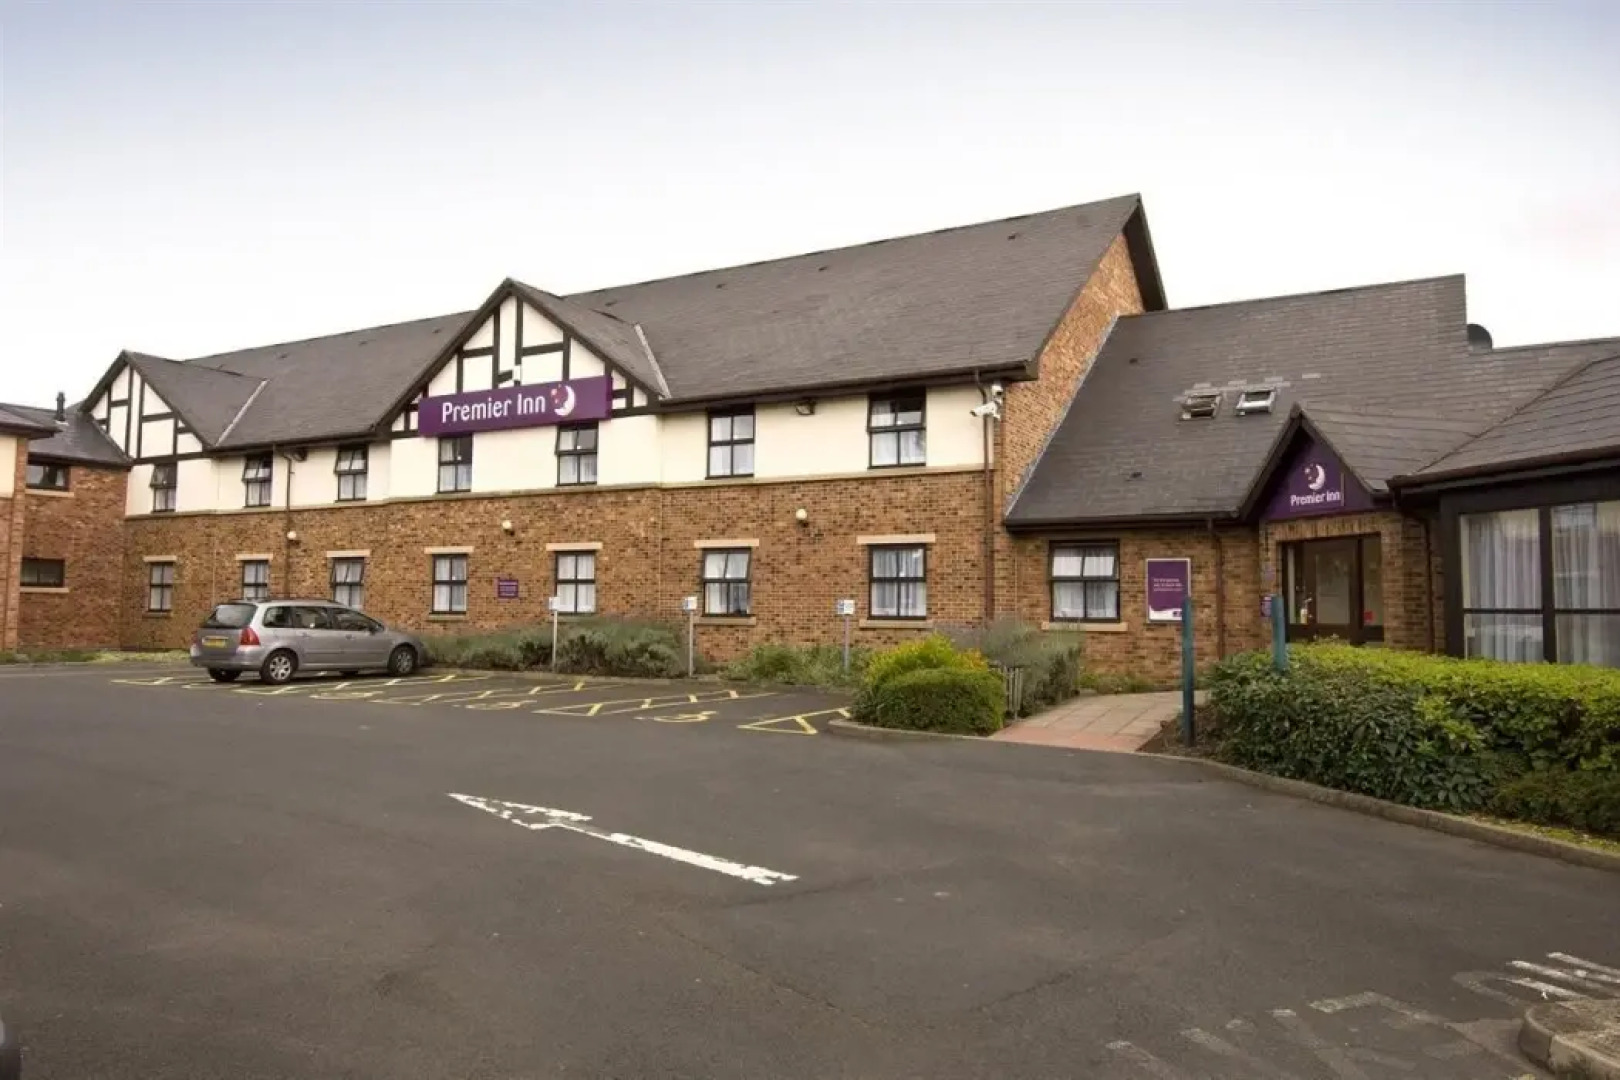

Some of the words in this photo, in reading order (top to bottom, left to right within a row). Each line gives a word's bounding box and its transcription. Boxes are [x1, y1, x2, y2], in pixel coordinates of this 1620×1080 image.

[441, 396, 512, 424] Premier
[517, 393, 546, 415] Inn
[1290, 492, 1325, 507] Premier
[1326, 490, 1340, 502] Inn
